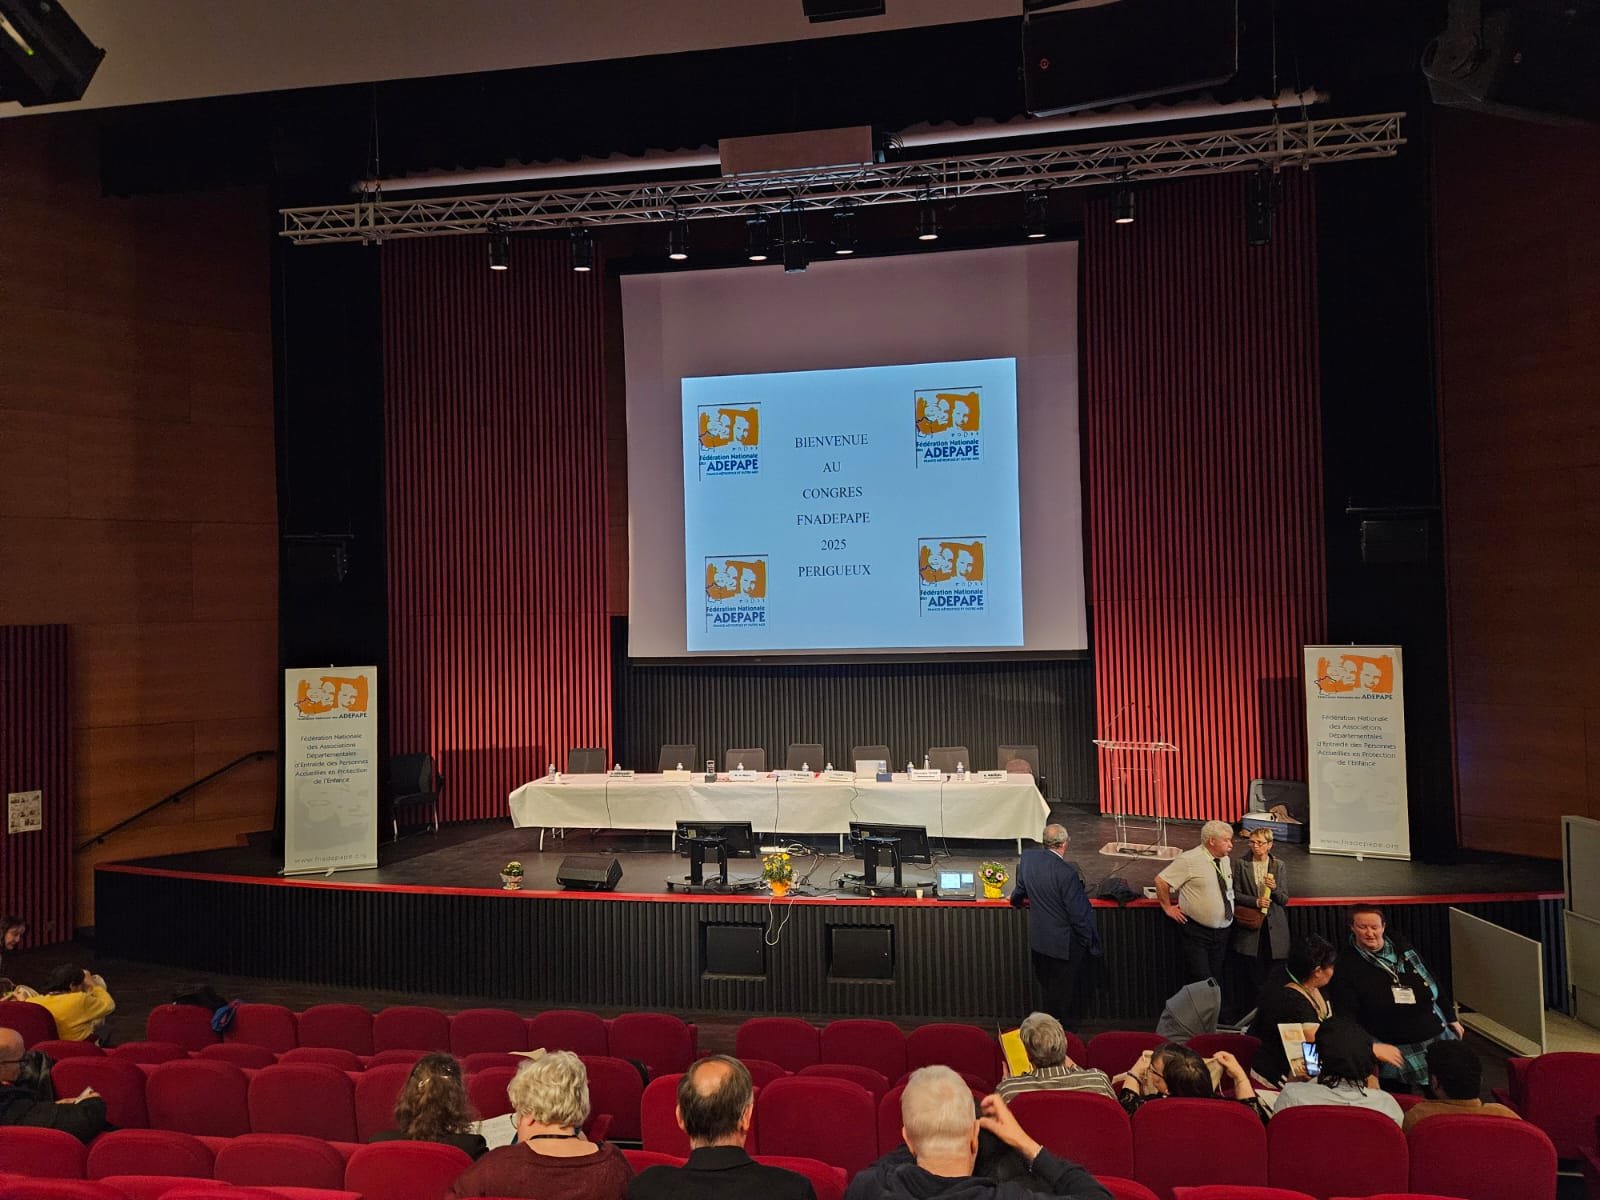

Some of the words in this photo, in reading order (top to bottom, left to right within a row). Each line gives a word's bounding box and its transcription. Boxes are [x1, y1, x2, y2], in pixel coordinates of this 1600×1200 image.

[795, 434, 868, 448] BIENVENUE
[925, 446, 979, 458] ADEPAPE
[707, 459, 758, 471] ADEPAPE
[823, 461, 840, 472] AU
[803, 486, 862, 499] CONGRES
[797, 512, 870, 526] FNADEPAPE
[821, 539, 846, 550] 2025
[798, 564, 871, 577] PERIGUEUX
[928, 595, 984, 606] ADEPAPE
[714, 612, 766, 623] ADEPAPE
